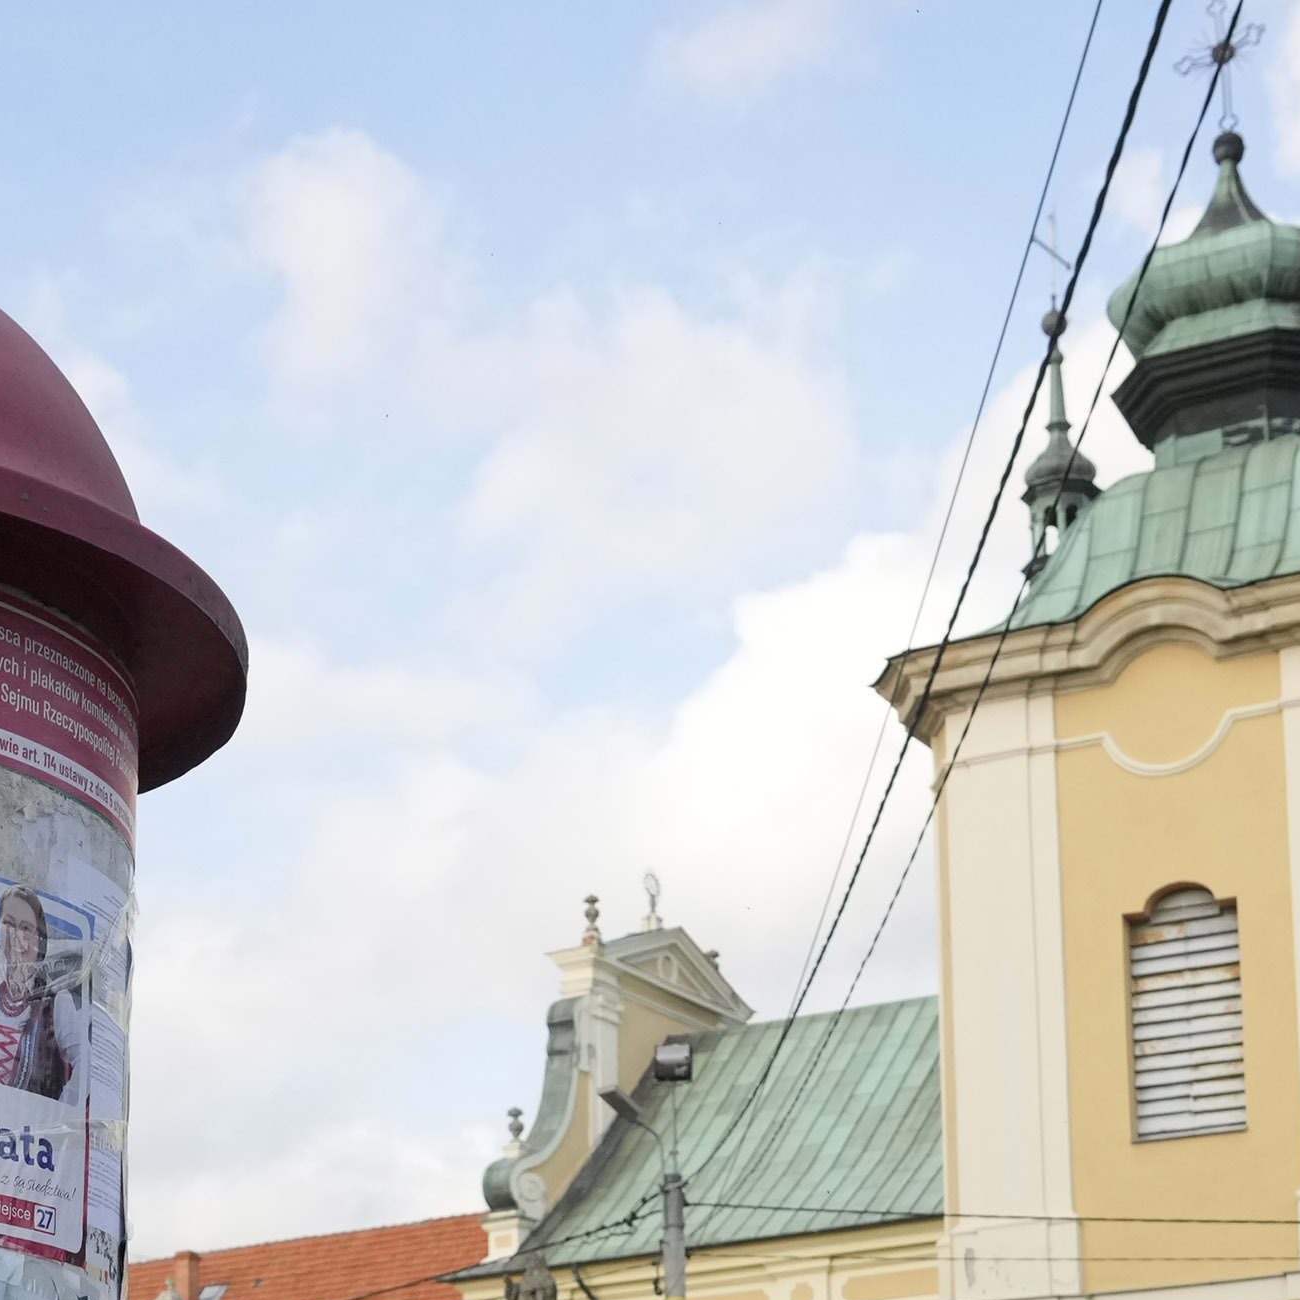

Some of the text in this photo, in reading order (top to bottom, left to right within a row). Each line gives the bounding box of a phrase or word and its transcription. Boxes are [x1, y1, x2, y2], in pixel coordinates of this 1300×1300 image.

[24, 636, 96, 687] przeznaczone
[97, 677, 107, 697] na
[1, 684, 40, 716] Sejmu
[43, 703, 116, 768] Rzeczypospolitej
[23, 661, 27, 680] i
[30, 667, 80, 706] plakatów
[81, 691, 118, 737] komitetów
[22, 745, 40, 764] art.
[43, 751, 57, 772] 114
[59, 762, 89, 792] ustawy
[89, 780, 94, 793] z
[1, 1174, 10, 1185] z
[13, 1175, 76, 1202] sąsiedztwa!
[36, 1209, 54, 1230] 27
